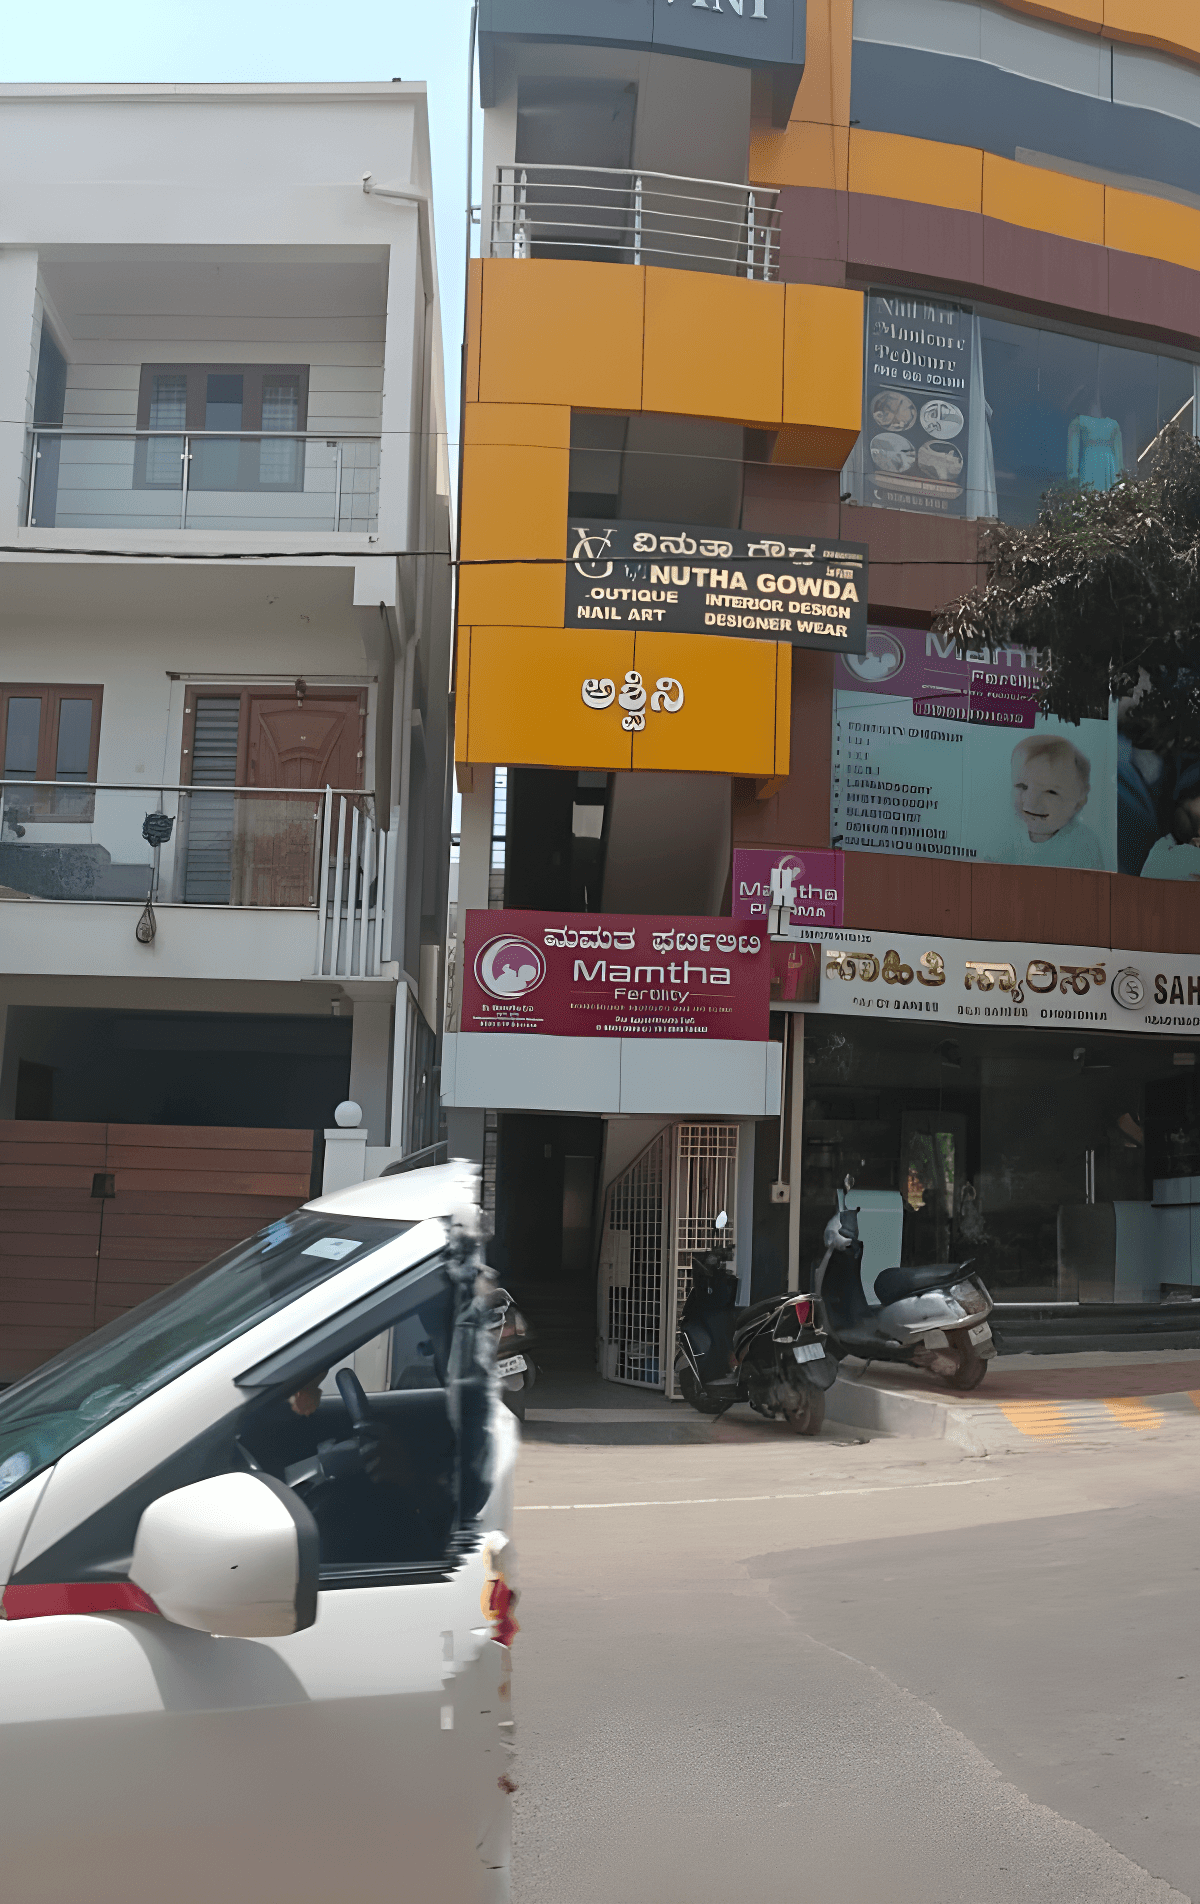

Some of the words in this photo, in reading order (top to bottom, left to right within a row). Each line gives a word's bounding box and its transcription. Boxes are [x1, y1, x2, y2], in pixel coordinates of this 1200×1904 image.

[624, 563, 748, 591] NUTHA
[756, 573, 860, 603] GOWDA
[584, 587, 679, 604] OUTIQUE
[705, 593, 784, 613] INTERIOR
[788, 601, 851, 620] DESIGN
[577, 605, 622, 620] NAIL
[627, 608, 667, 622] ART
[704, 612, 793, 632] DESIGNER
[796, 620, 848, 638] WEAR
[581, 670, 684, 731] ಅಶ್ವಿನಿ
[739, 881, 838, 901] Matha
[573, 959, 731, 985] Mamtha
